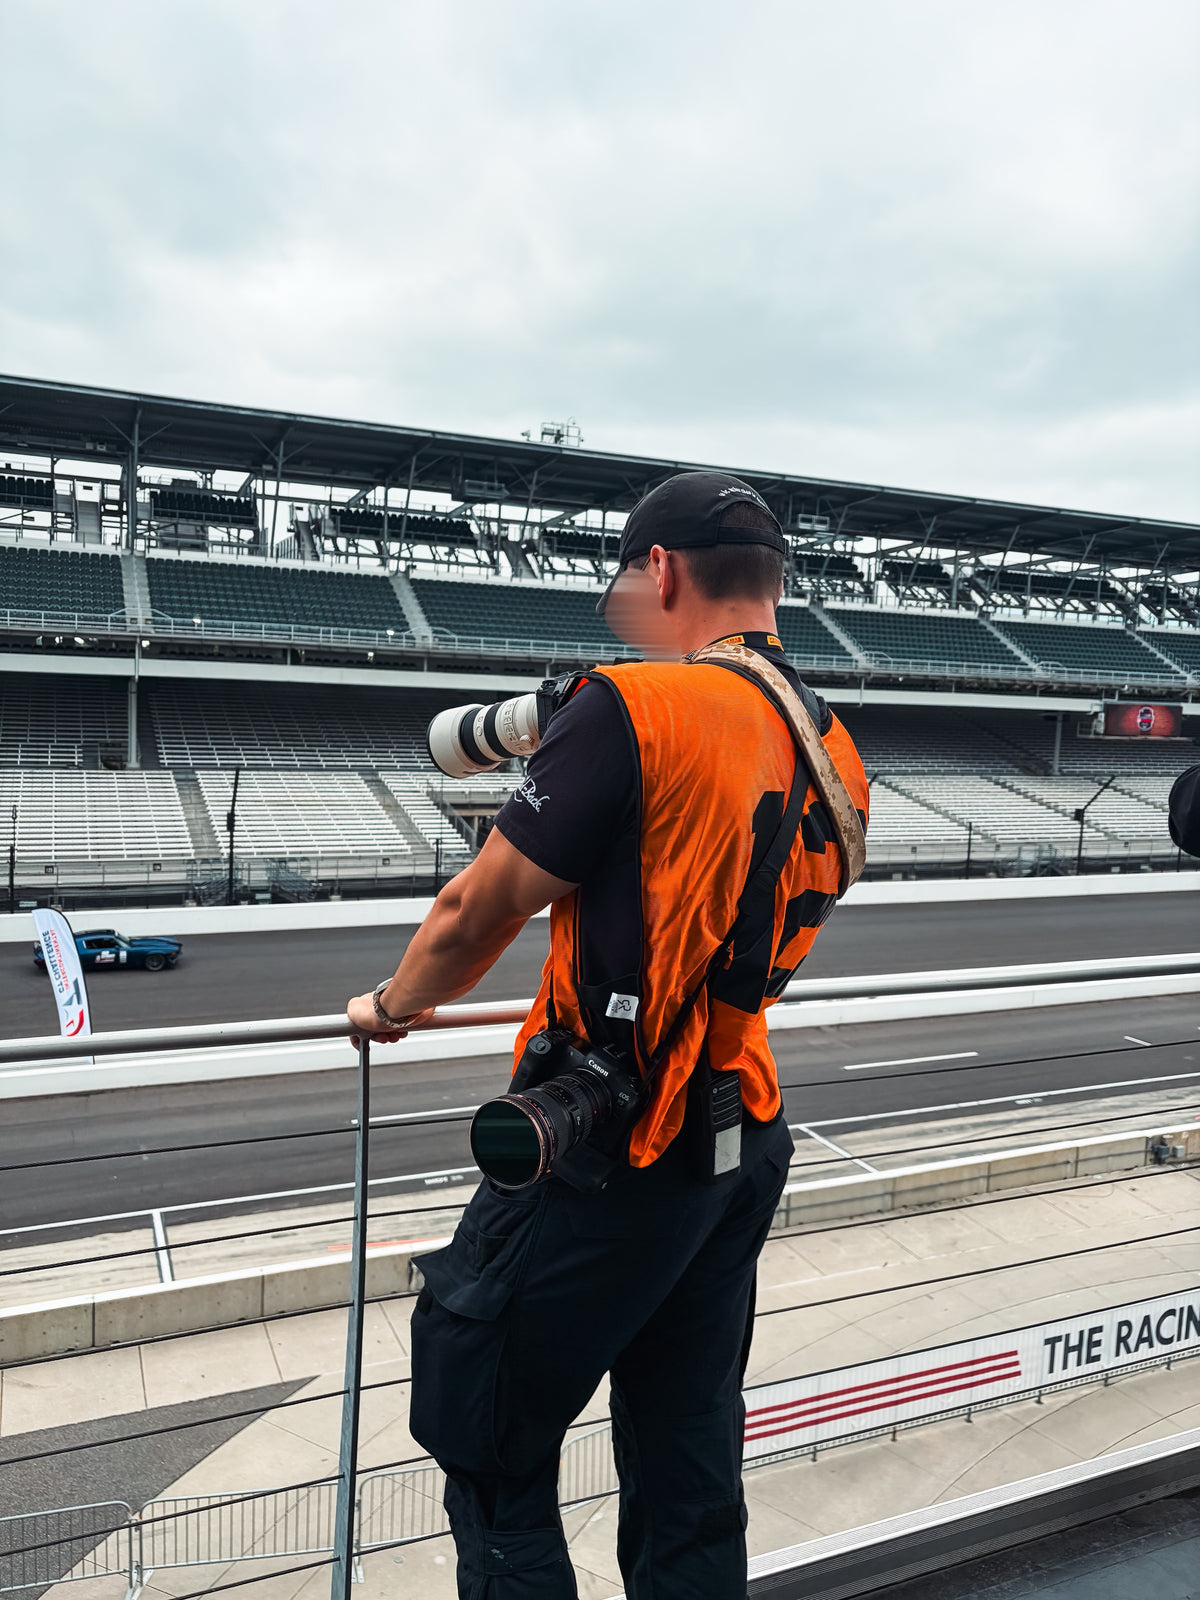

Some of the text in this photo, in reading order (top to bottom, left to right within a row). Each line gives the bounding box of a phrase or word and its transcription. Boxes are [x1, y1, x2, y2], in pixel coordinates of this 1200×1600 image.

[588, 1059, 609, 1077] Canon
[618, 1091, 630, 1102] EOS
[1043, 1304, 1200, 1374] THE RACIN
